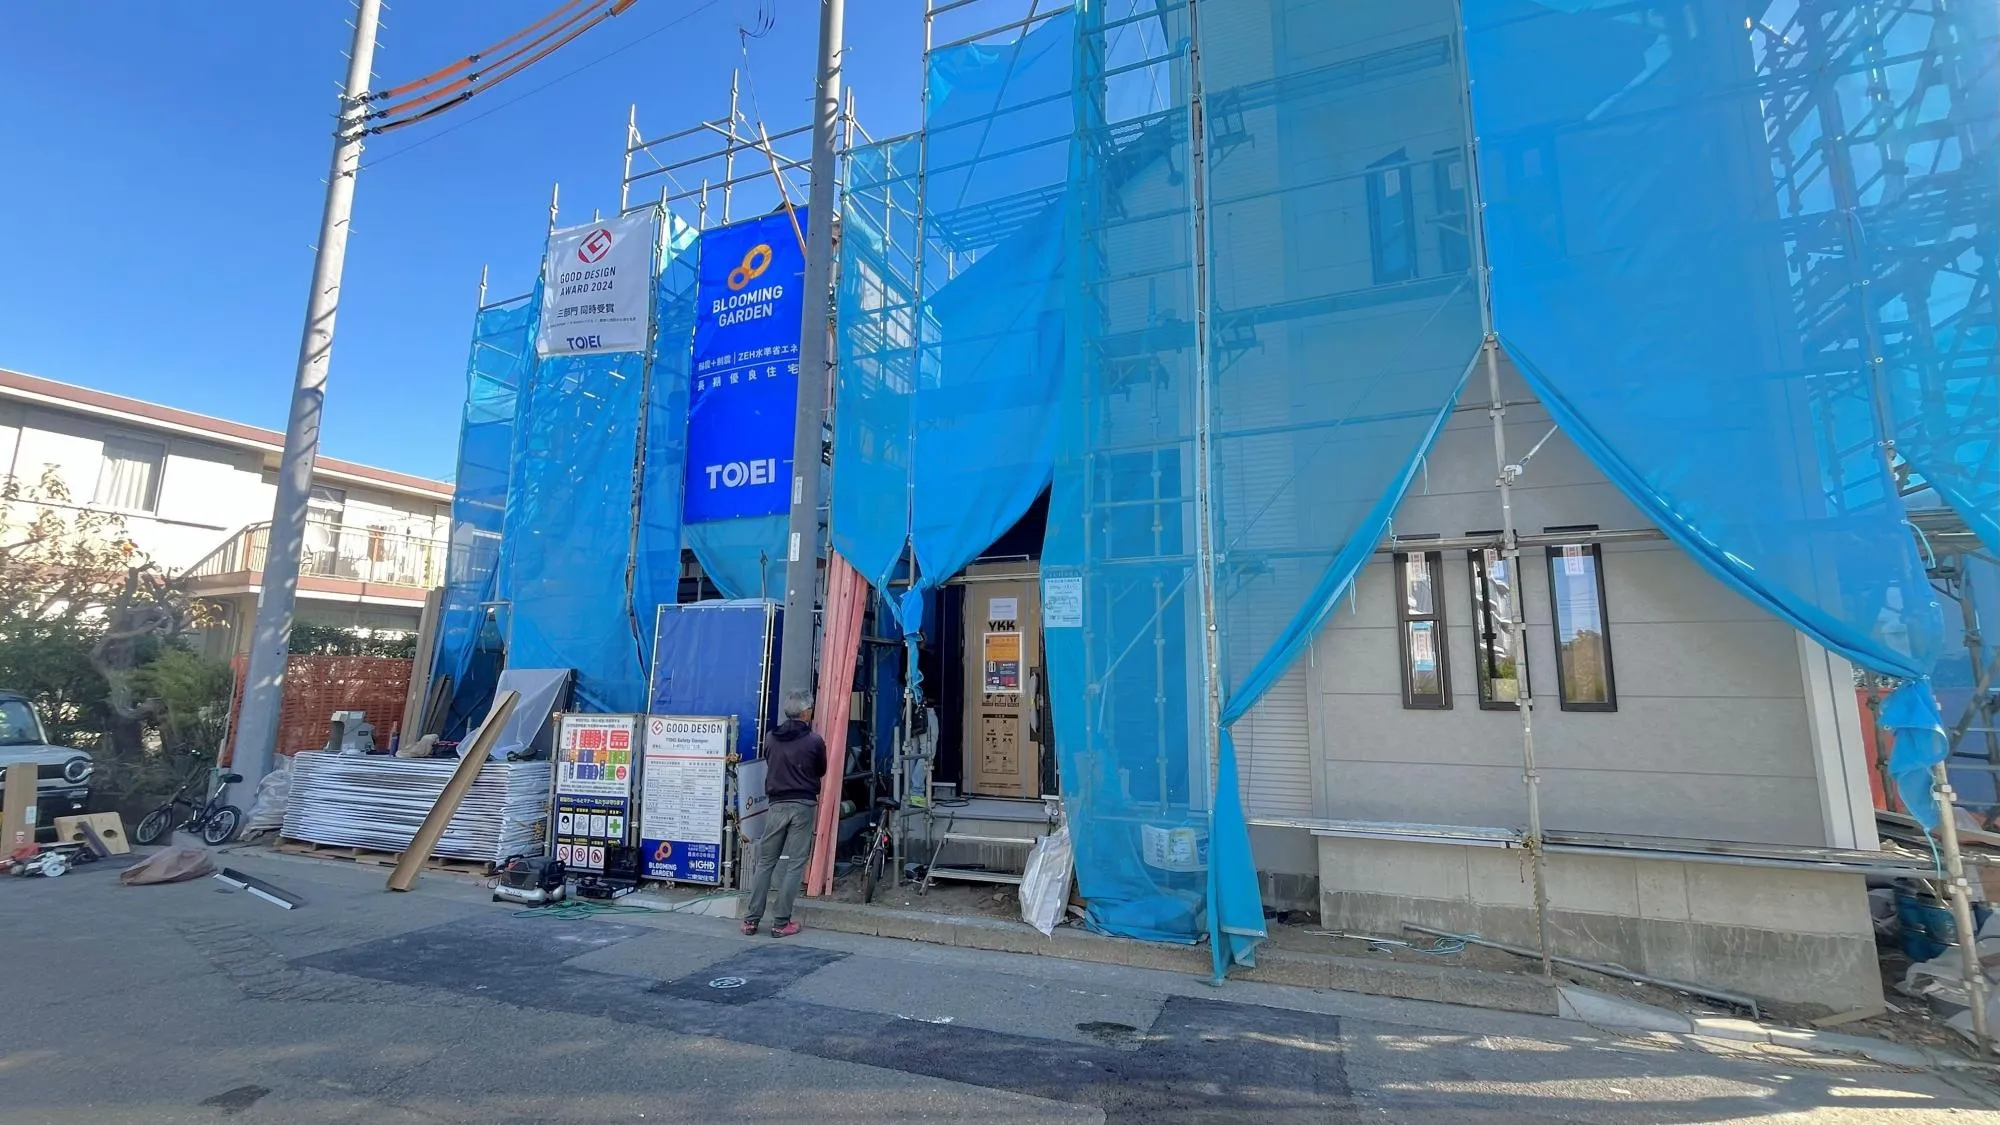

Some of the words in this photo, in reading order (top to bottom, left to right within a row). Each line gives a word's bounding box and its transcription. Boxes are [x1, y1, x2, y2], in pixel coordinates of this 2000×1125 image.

[560, 271, 582, 284] GOOD
[584, 266, 616, 280] DESIGN
[560, 283, 589, 296] AWARD
[591, 280, 613, 292] 2024
[712, 285, 784, 314] BLOOMING
[557, 305, 579, 318] 三部門
[580, 303, 615, 315] 同時受賞
[718, 303, 773, 327] GARDEN
[988, 620, 1016, 632] YKK
[666, 723, 689, 733] GOOD
[691, 723, 723, 734] DESIGN
[648, 862, 677, 871] BLOOMING
[651, 869, 674, 878] GARDEN
